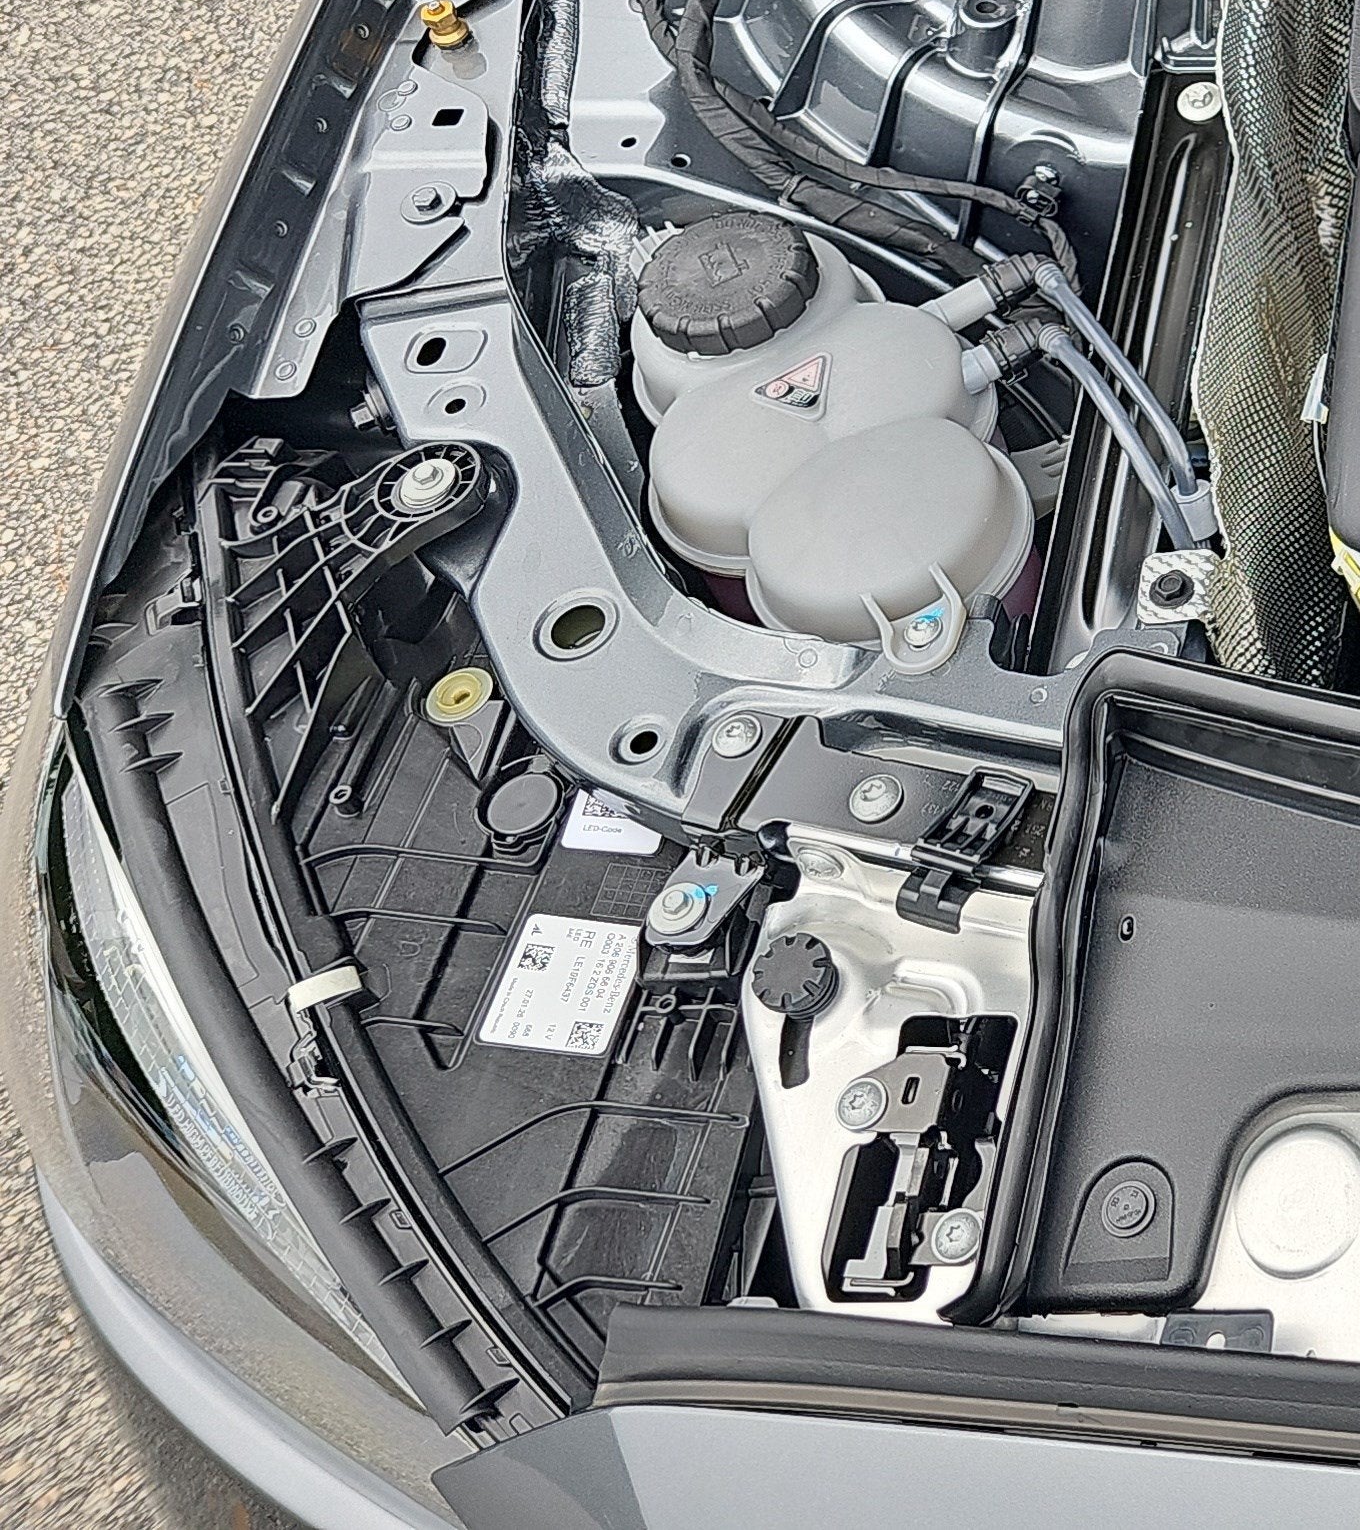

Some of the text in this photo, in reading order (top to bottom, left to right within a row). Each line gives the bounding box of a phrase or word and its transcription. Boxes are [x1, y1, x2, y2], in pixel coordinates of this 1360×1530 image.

[582, 824, 622, 833] LED-Code
[580, 930, 596, 948] RE
[603, 945, 635, 1014] Mercedes-Benz
[547, 1023, 556, 1033] 12
